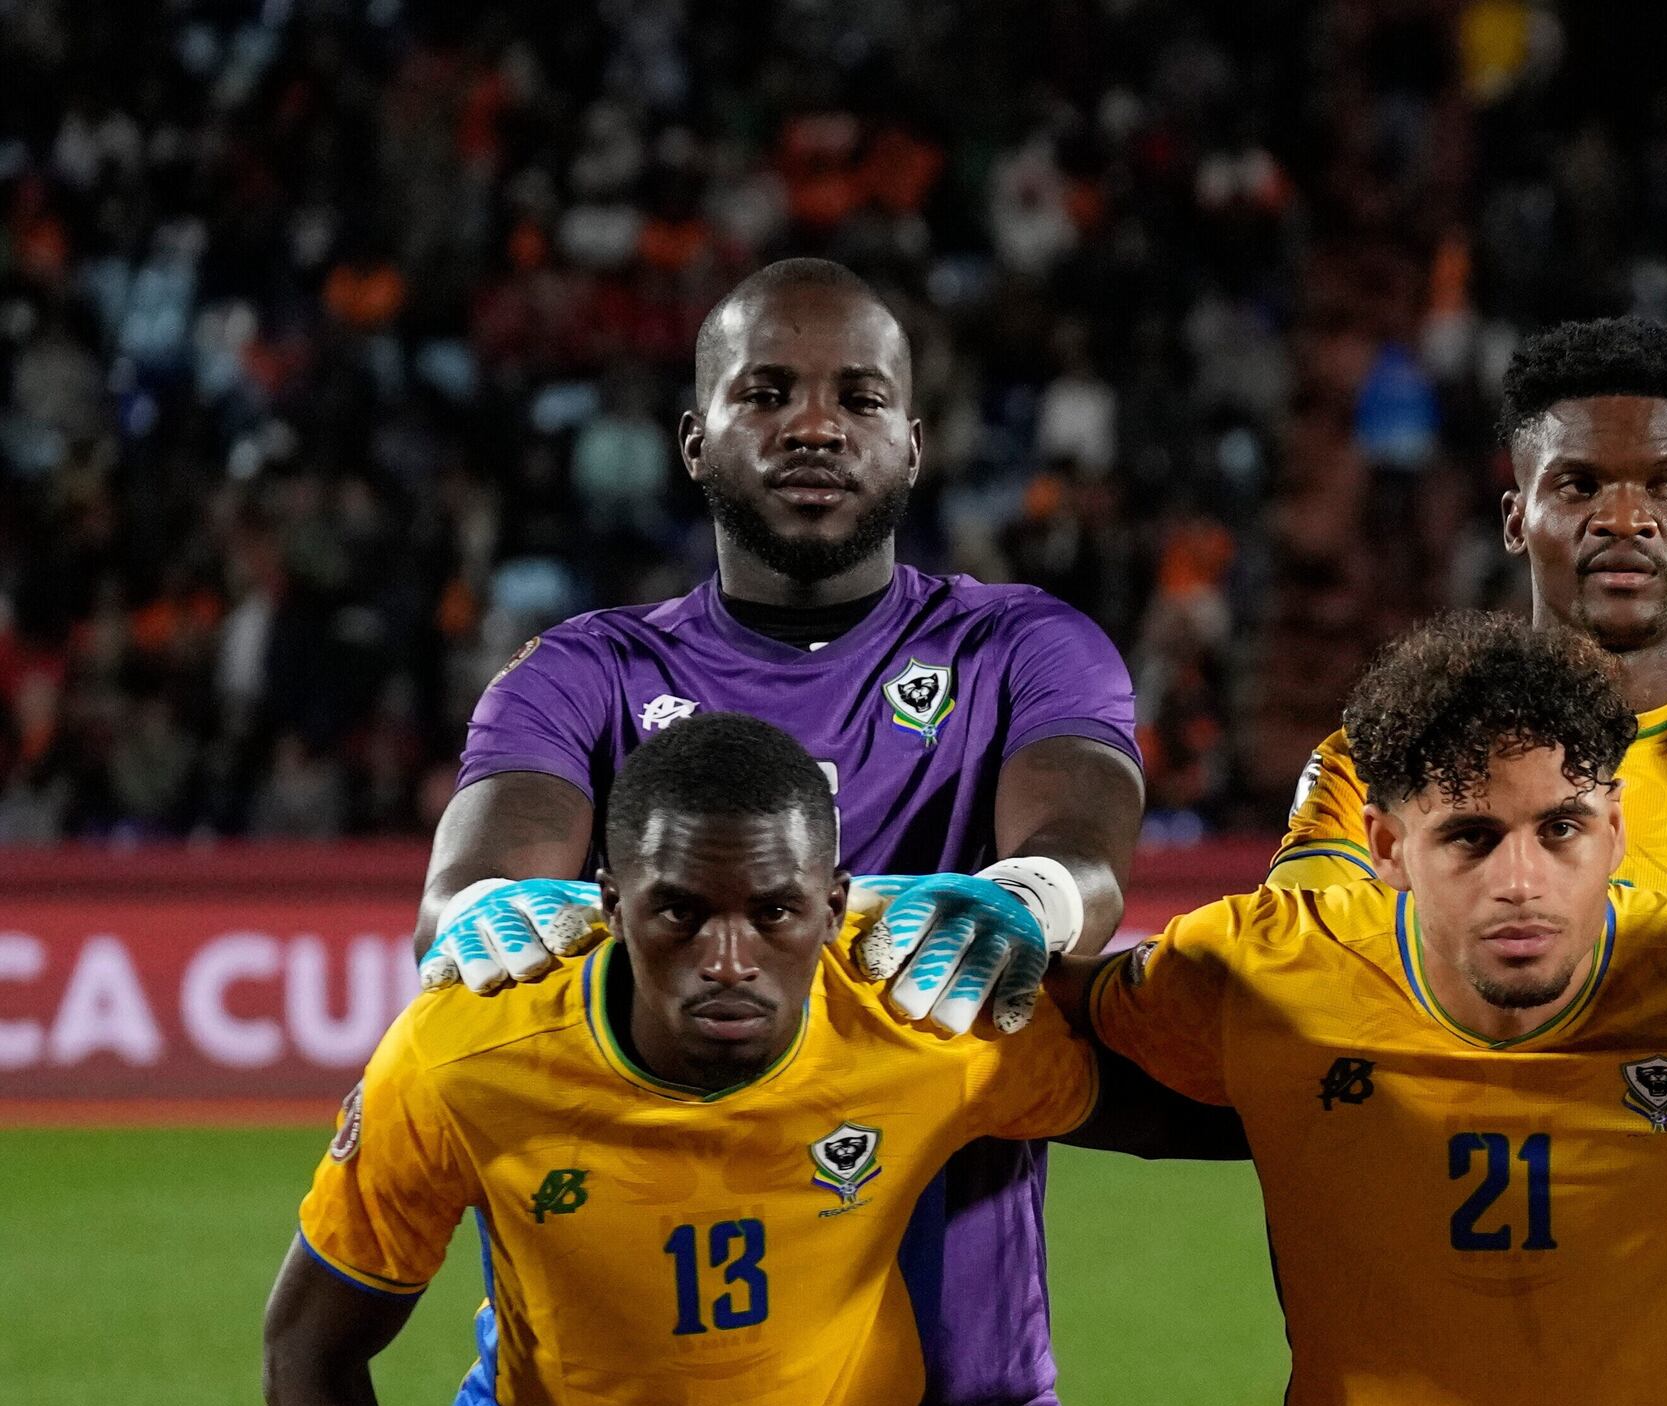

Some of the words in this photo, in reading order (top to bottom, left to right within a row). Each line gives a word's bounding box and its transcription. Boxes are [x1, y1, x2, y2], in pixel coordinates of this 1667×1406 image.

[180, 932, 419, 1070] CU
[1448, 1132, 1558, 1252] 21
[663, 1217, 768, 1336] 13
